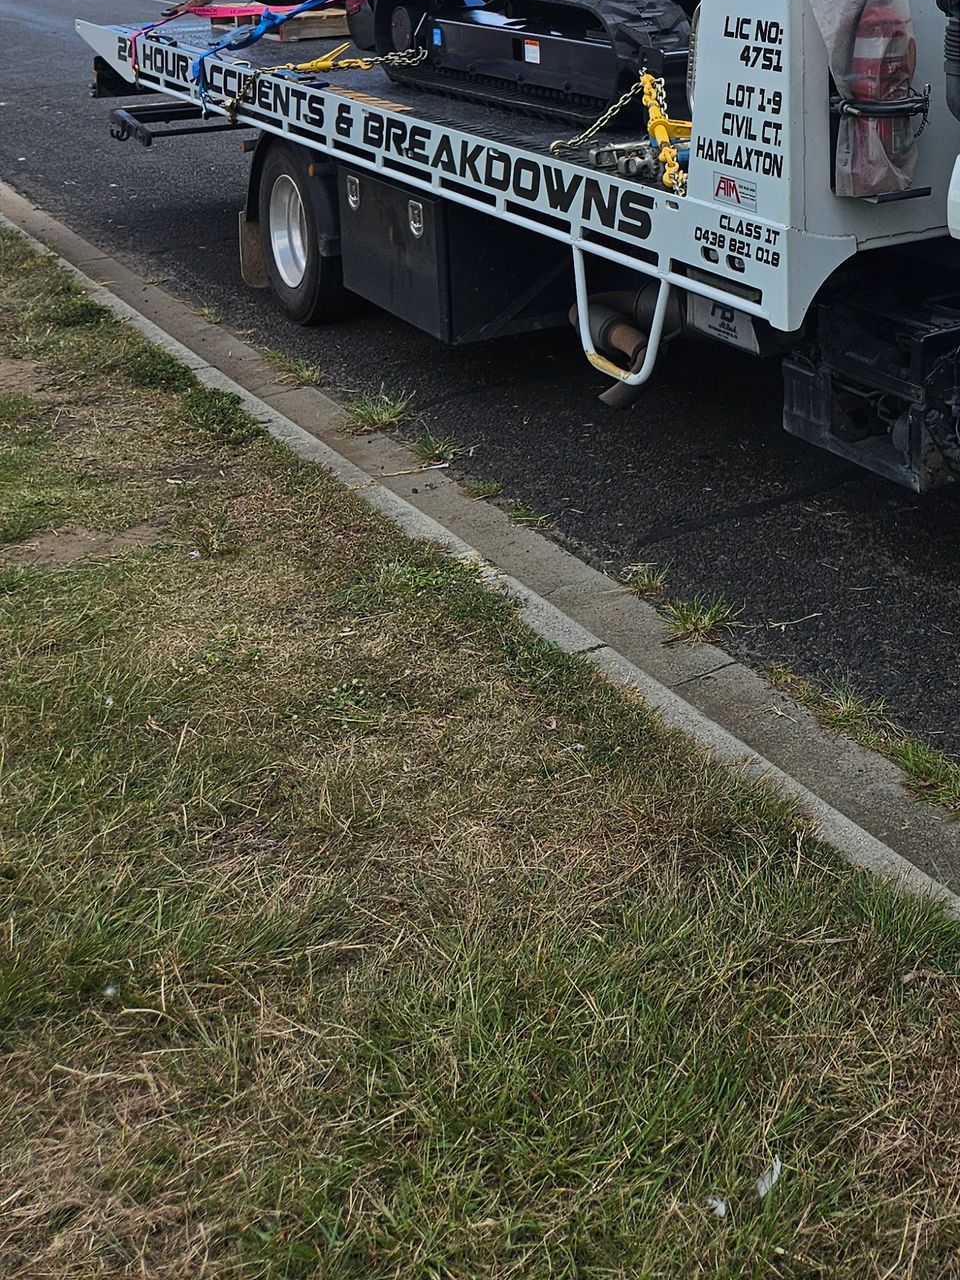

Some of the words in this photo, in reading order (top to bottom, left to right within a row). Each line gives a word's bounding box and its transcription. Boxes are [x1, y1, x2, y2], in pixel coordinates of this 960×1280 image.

[723, 16, 751, 40] LIC
[755, 19, 784, 45] NO:
[740, 45, 783, 72] 4751
[725, 82, 755, 109] LOT
[758, 88, 783, 114] 1-9
[142, 43, 189, 83] HOUR
[336, 104, 354, 138] &
[363, 112, 655, 240] BREAKDOWNS
[721, 112, 757, 141] CIVIL
[761, 120, 783, 147] CT.
[695, 135, 784, 178] HARLAXTON
[715, 176, 741, 204] ATM
[719, 214, 762, 240] CLASS
[694, 226, 726, 249] 0438
[729, 238, 752, 258] 821
[756, 246, 780, 267] 018
